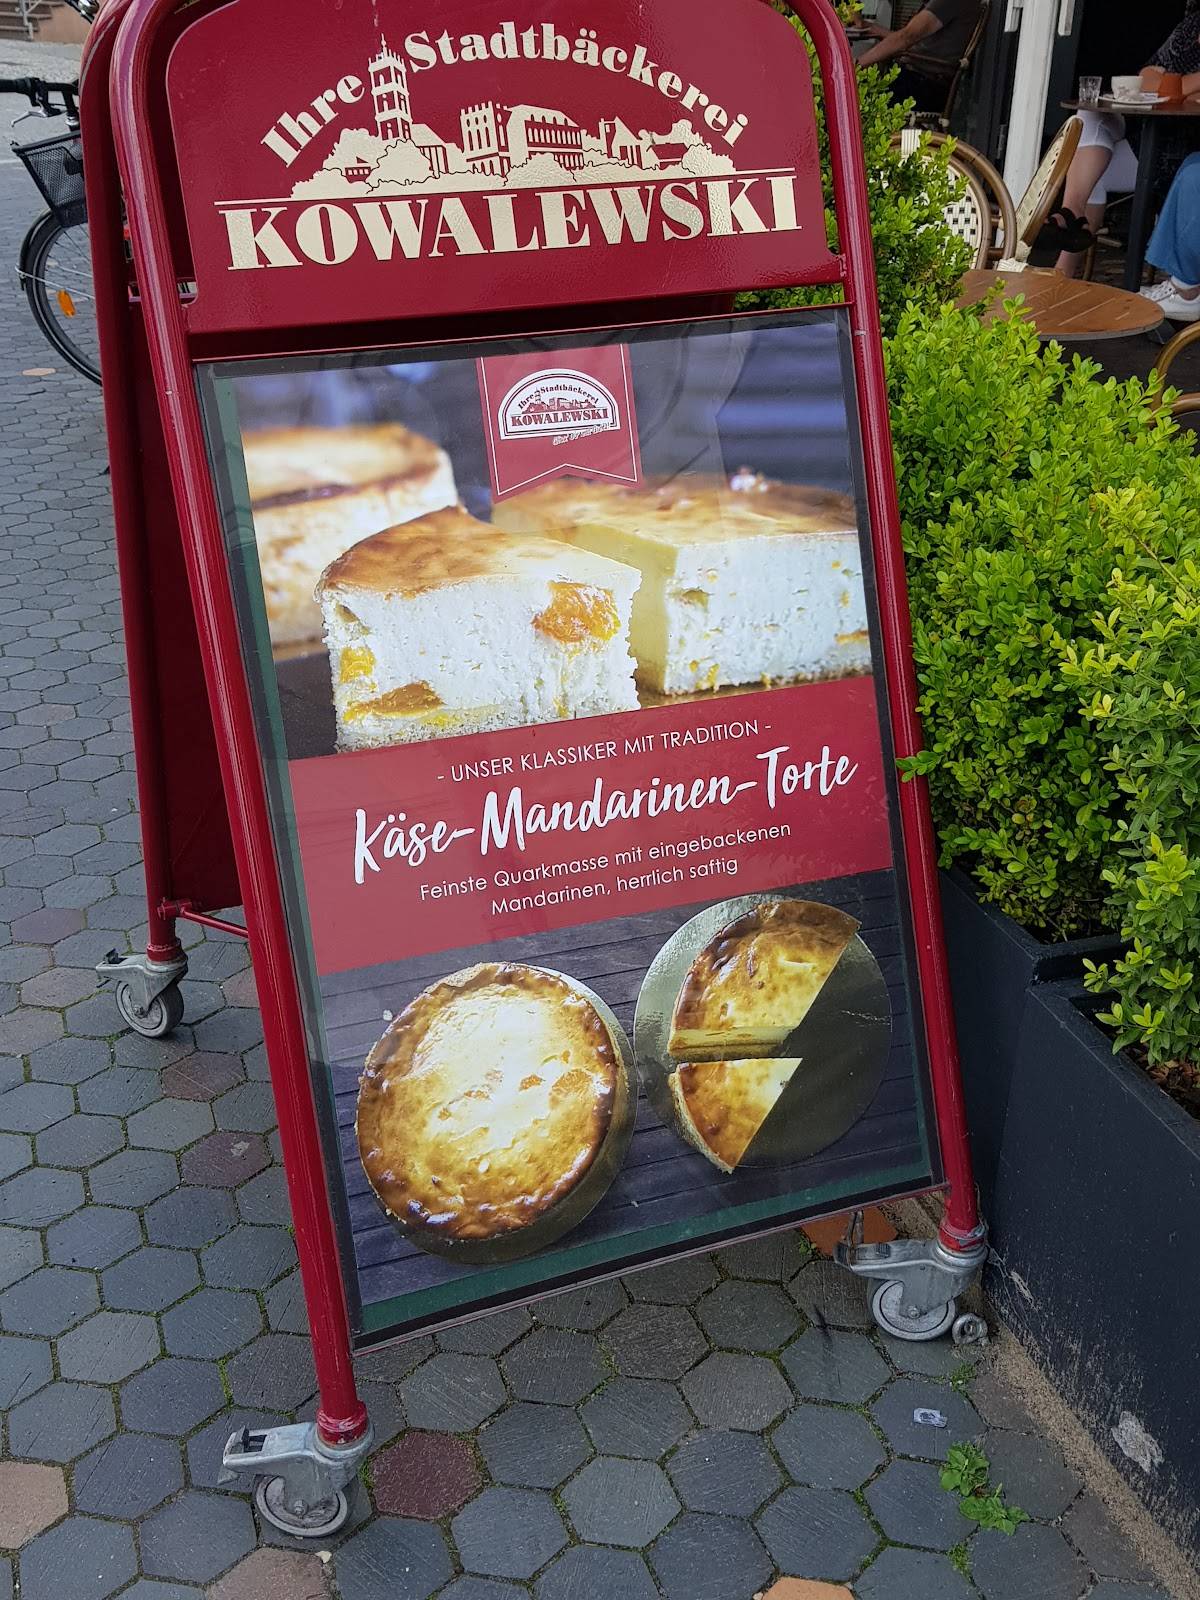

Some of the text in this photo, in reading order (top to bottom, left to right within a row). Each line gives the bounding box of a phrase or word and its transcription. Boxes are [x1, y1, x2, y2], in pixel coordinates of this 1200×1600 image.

[260, 21, 750, 168] Ihre Stadtbäckerei
[218, 174, 803, 271] KOWALEWSKI
[511, 408, 609, 427] KOWALEWSKI
[451, 757, 515, 782] UNSER
[520, 741, 618, 771] KLASSIKER
[624, 734, 655, 754] MIT
[660, 719, 760, 748] TRADITION
[354, 745, 859, 885] Käse-Mandarinen-Torte
[419, 823, 792, 901] Feinste Quarkmasse mit eingebackenen
[491, 857, 739, 915] Mandarinen, herrlich saftig
